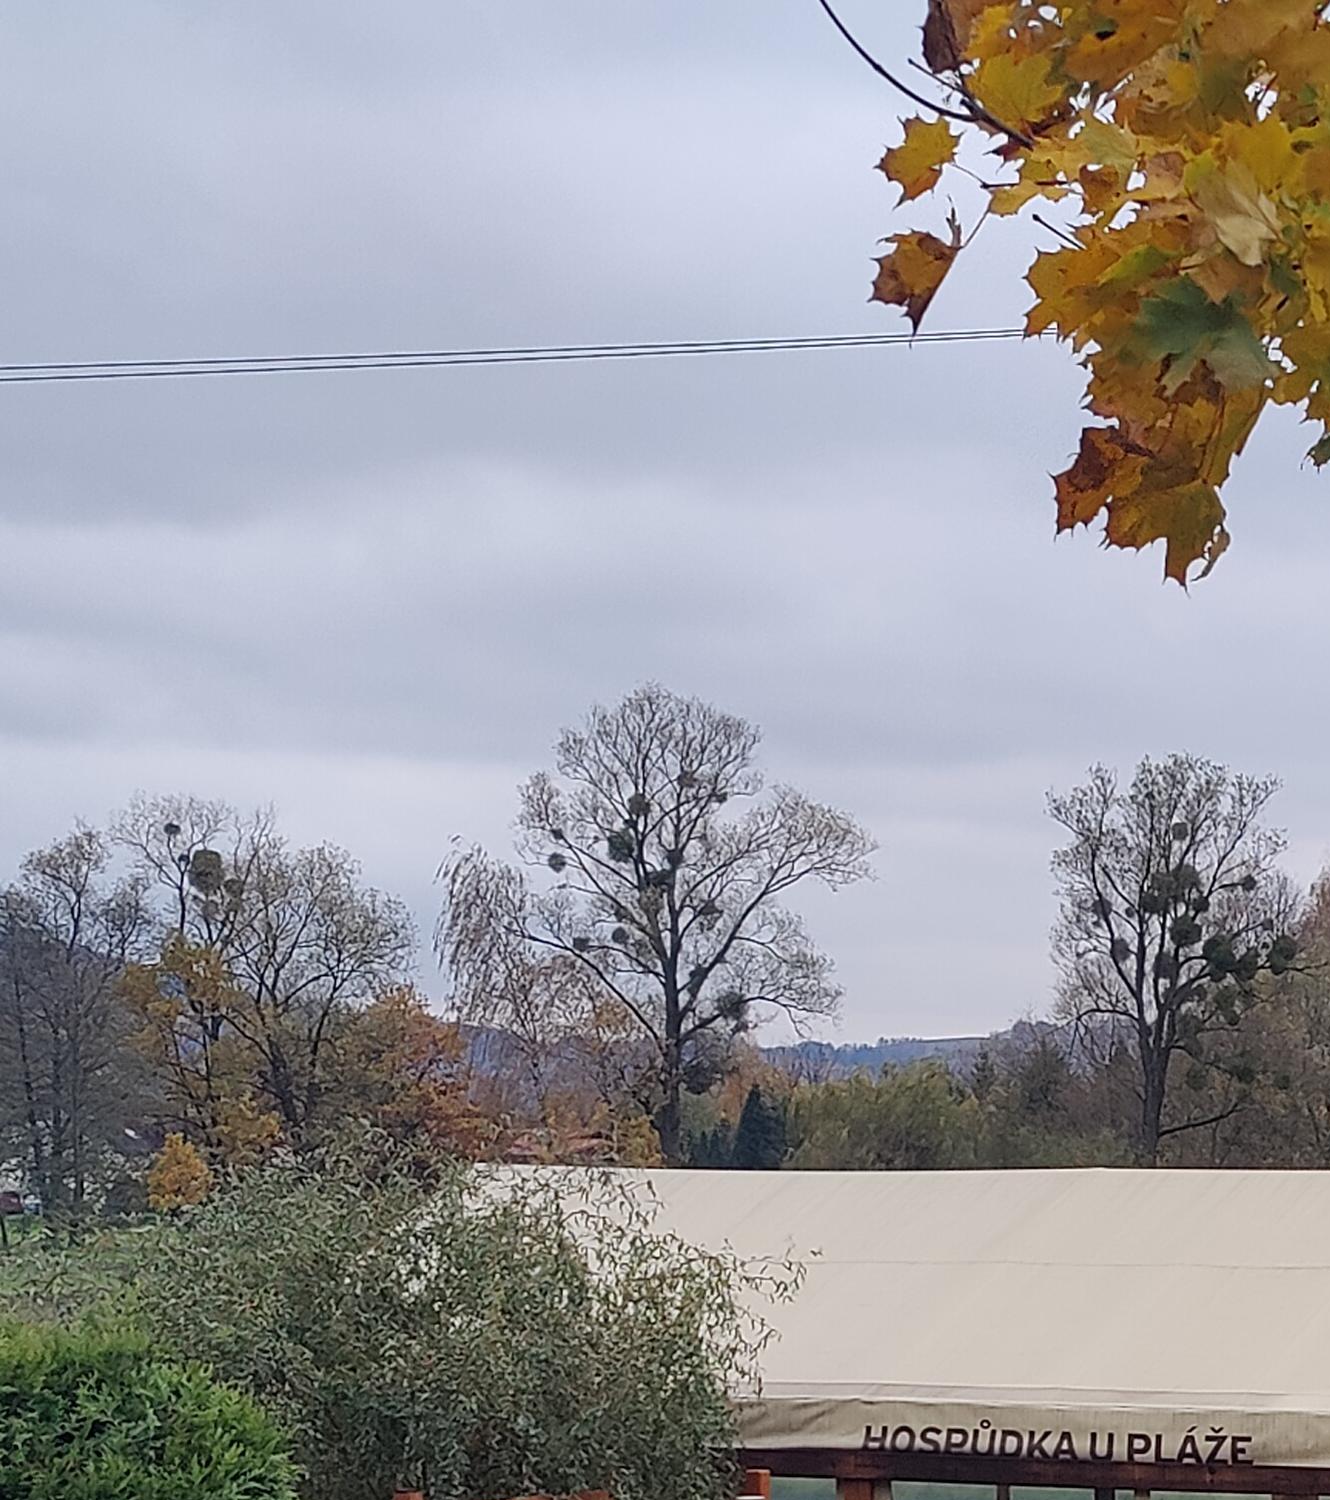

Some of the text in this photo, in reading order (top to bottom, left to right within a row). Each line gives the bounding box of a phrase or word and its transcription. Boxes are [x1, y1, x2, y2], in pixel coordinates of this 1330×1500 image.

[861, 1419, 1254, 1466] HOSPŮDKA U PLÁŽE
